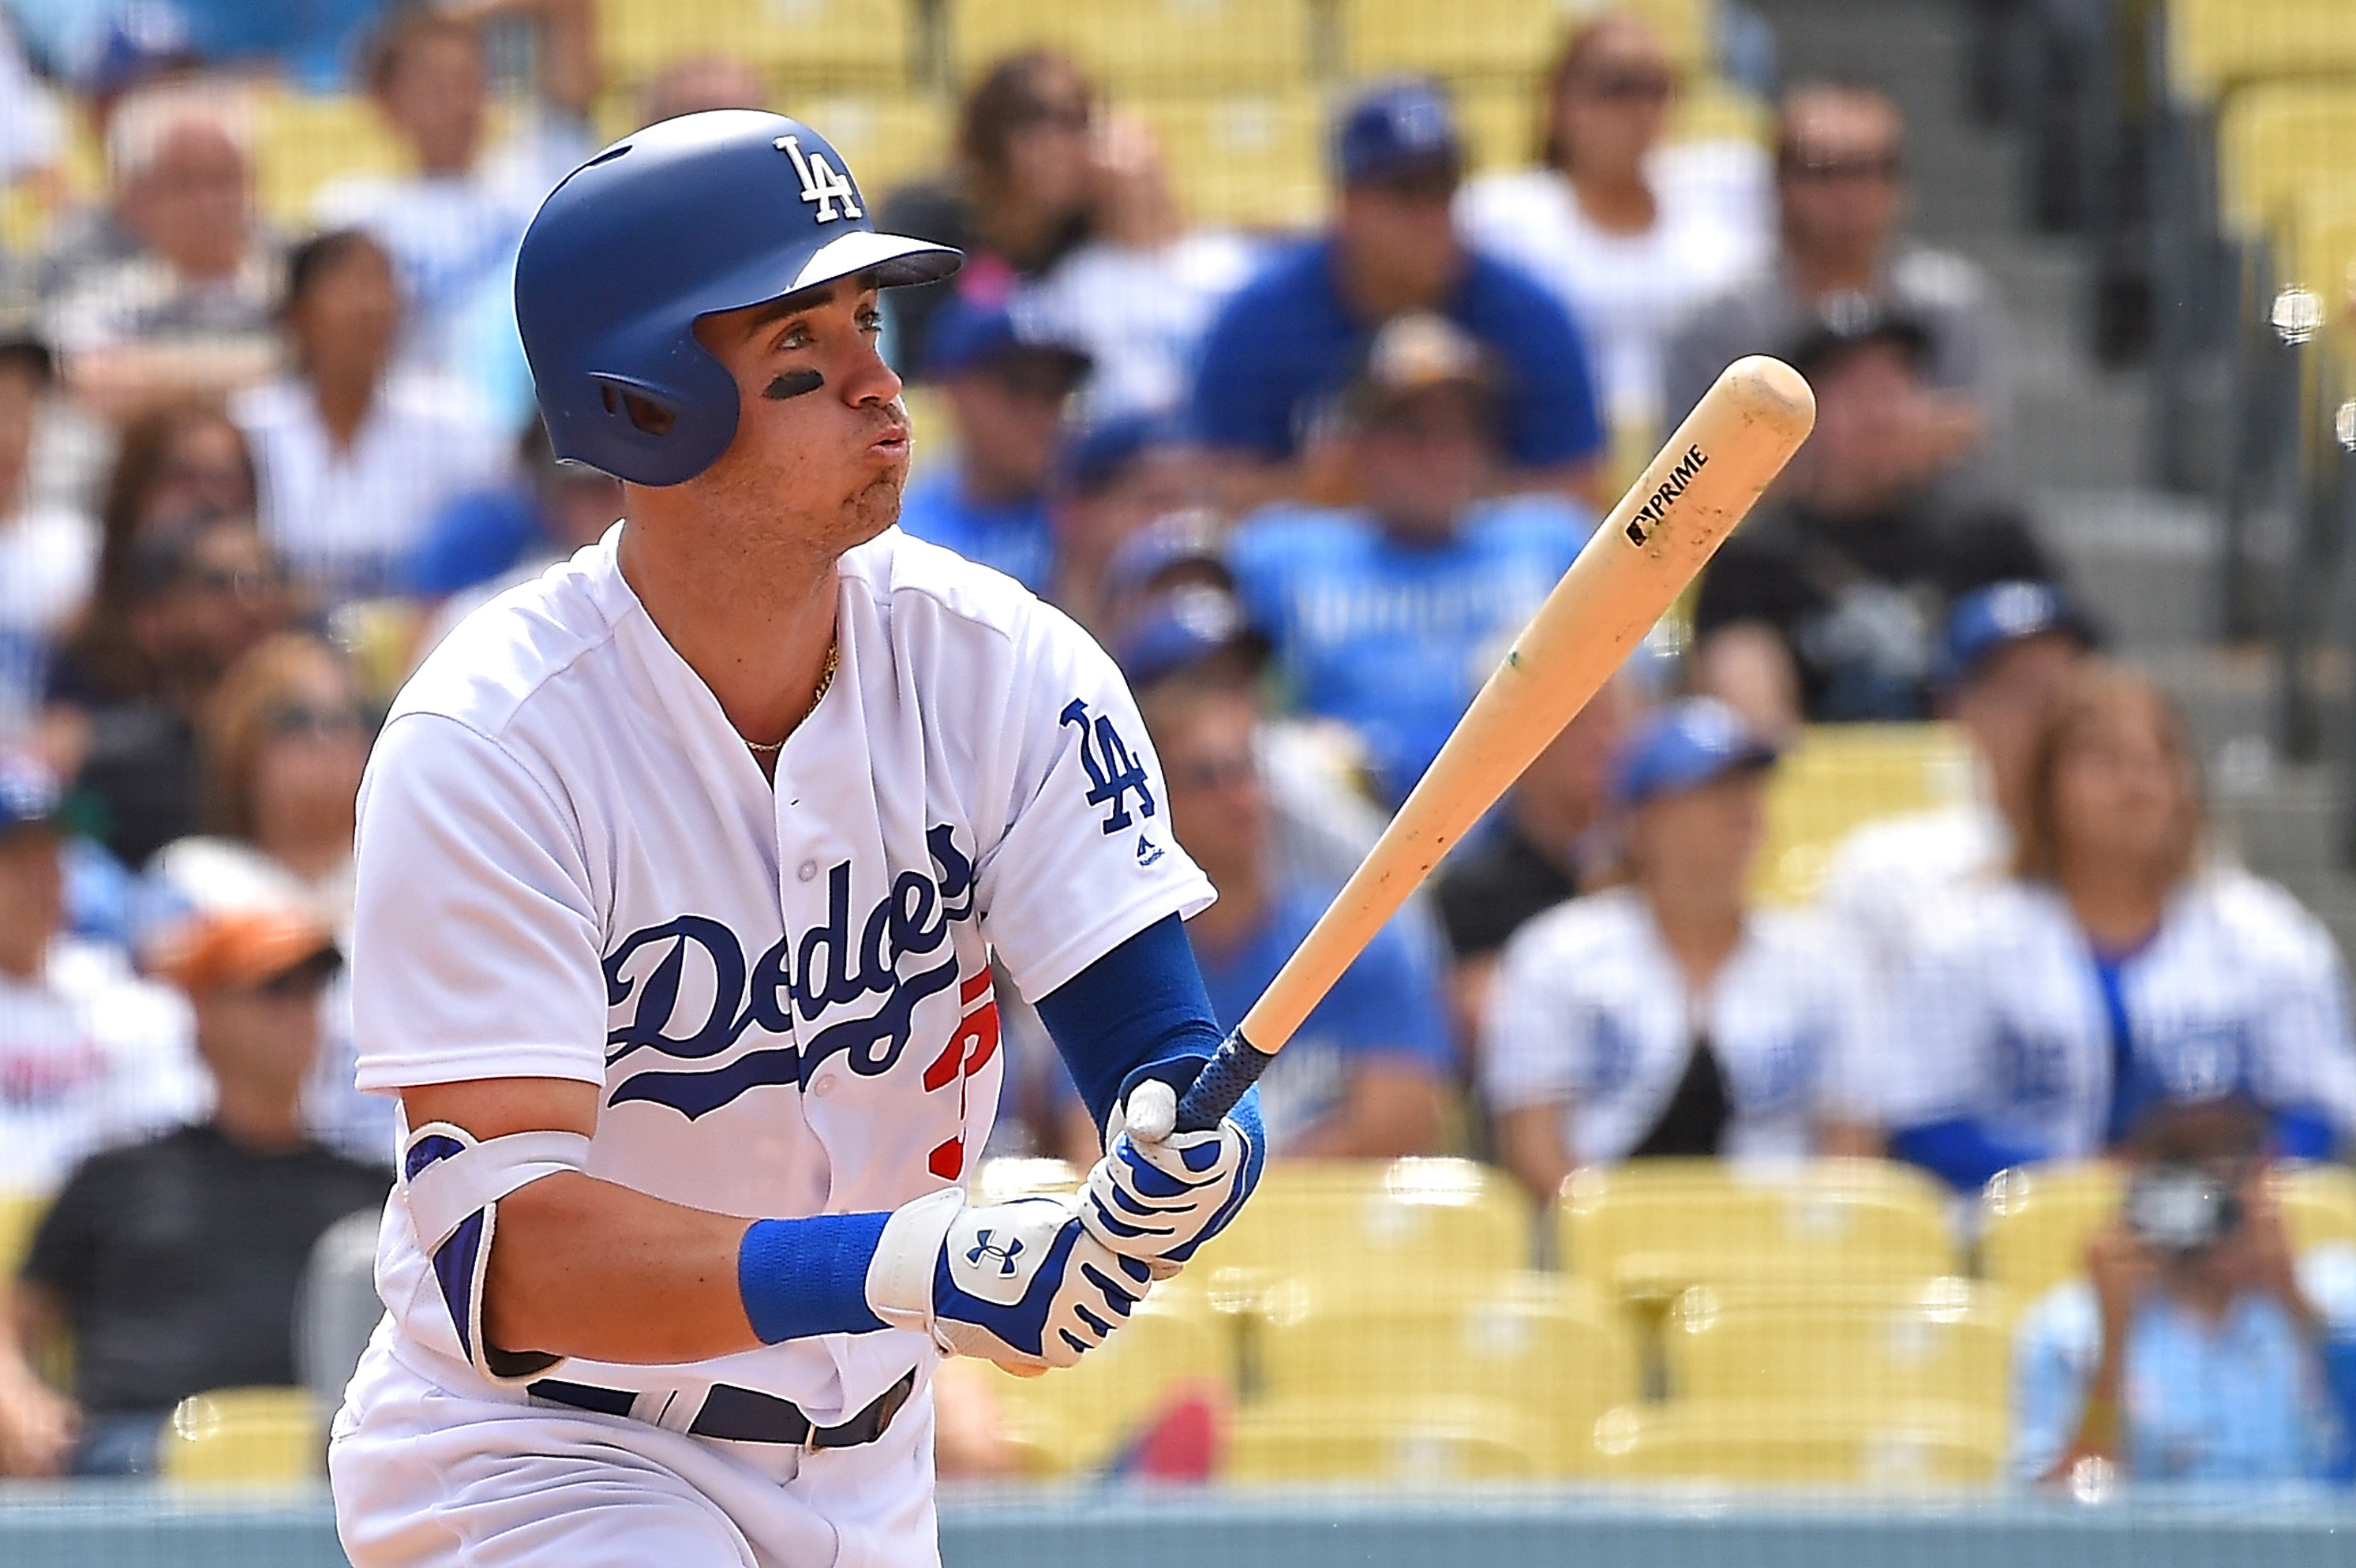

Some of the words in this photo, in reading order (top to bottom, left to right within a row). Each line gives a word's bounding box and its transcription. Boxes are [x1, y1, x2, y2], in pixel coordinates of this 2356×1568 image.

[773, 135, 863, 223] LA
[1649, 443, 1710, 517] PRIME
[1059, 698, 1155, 835] LA
[601, 822, 974, 1078] Dodges
